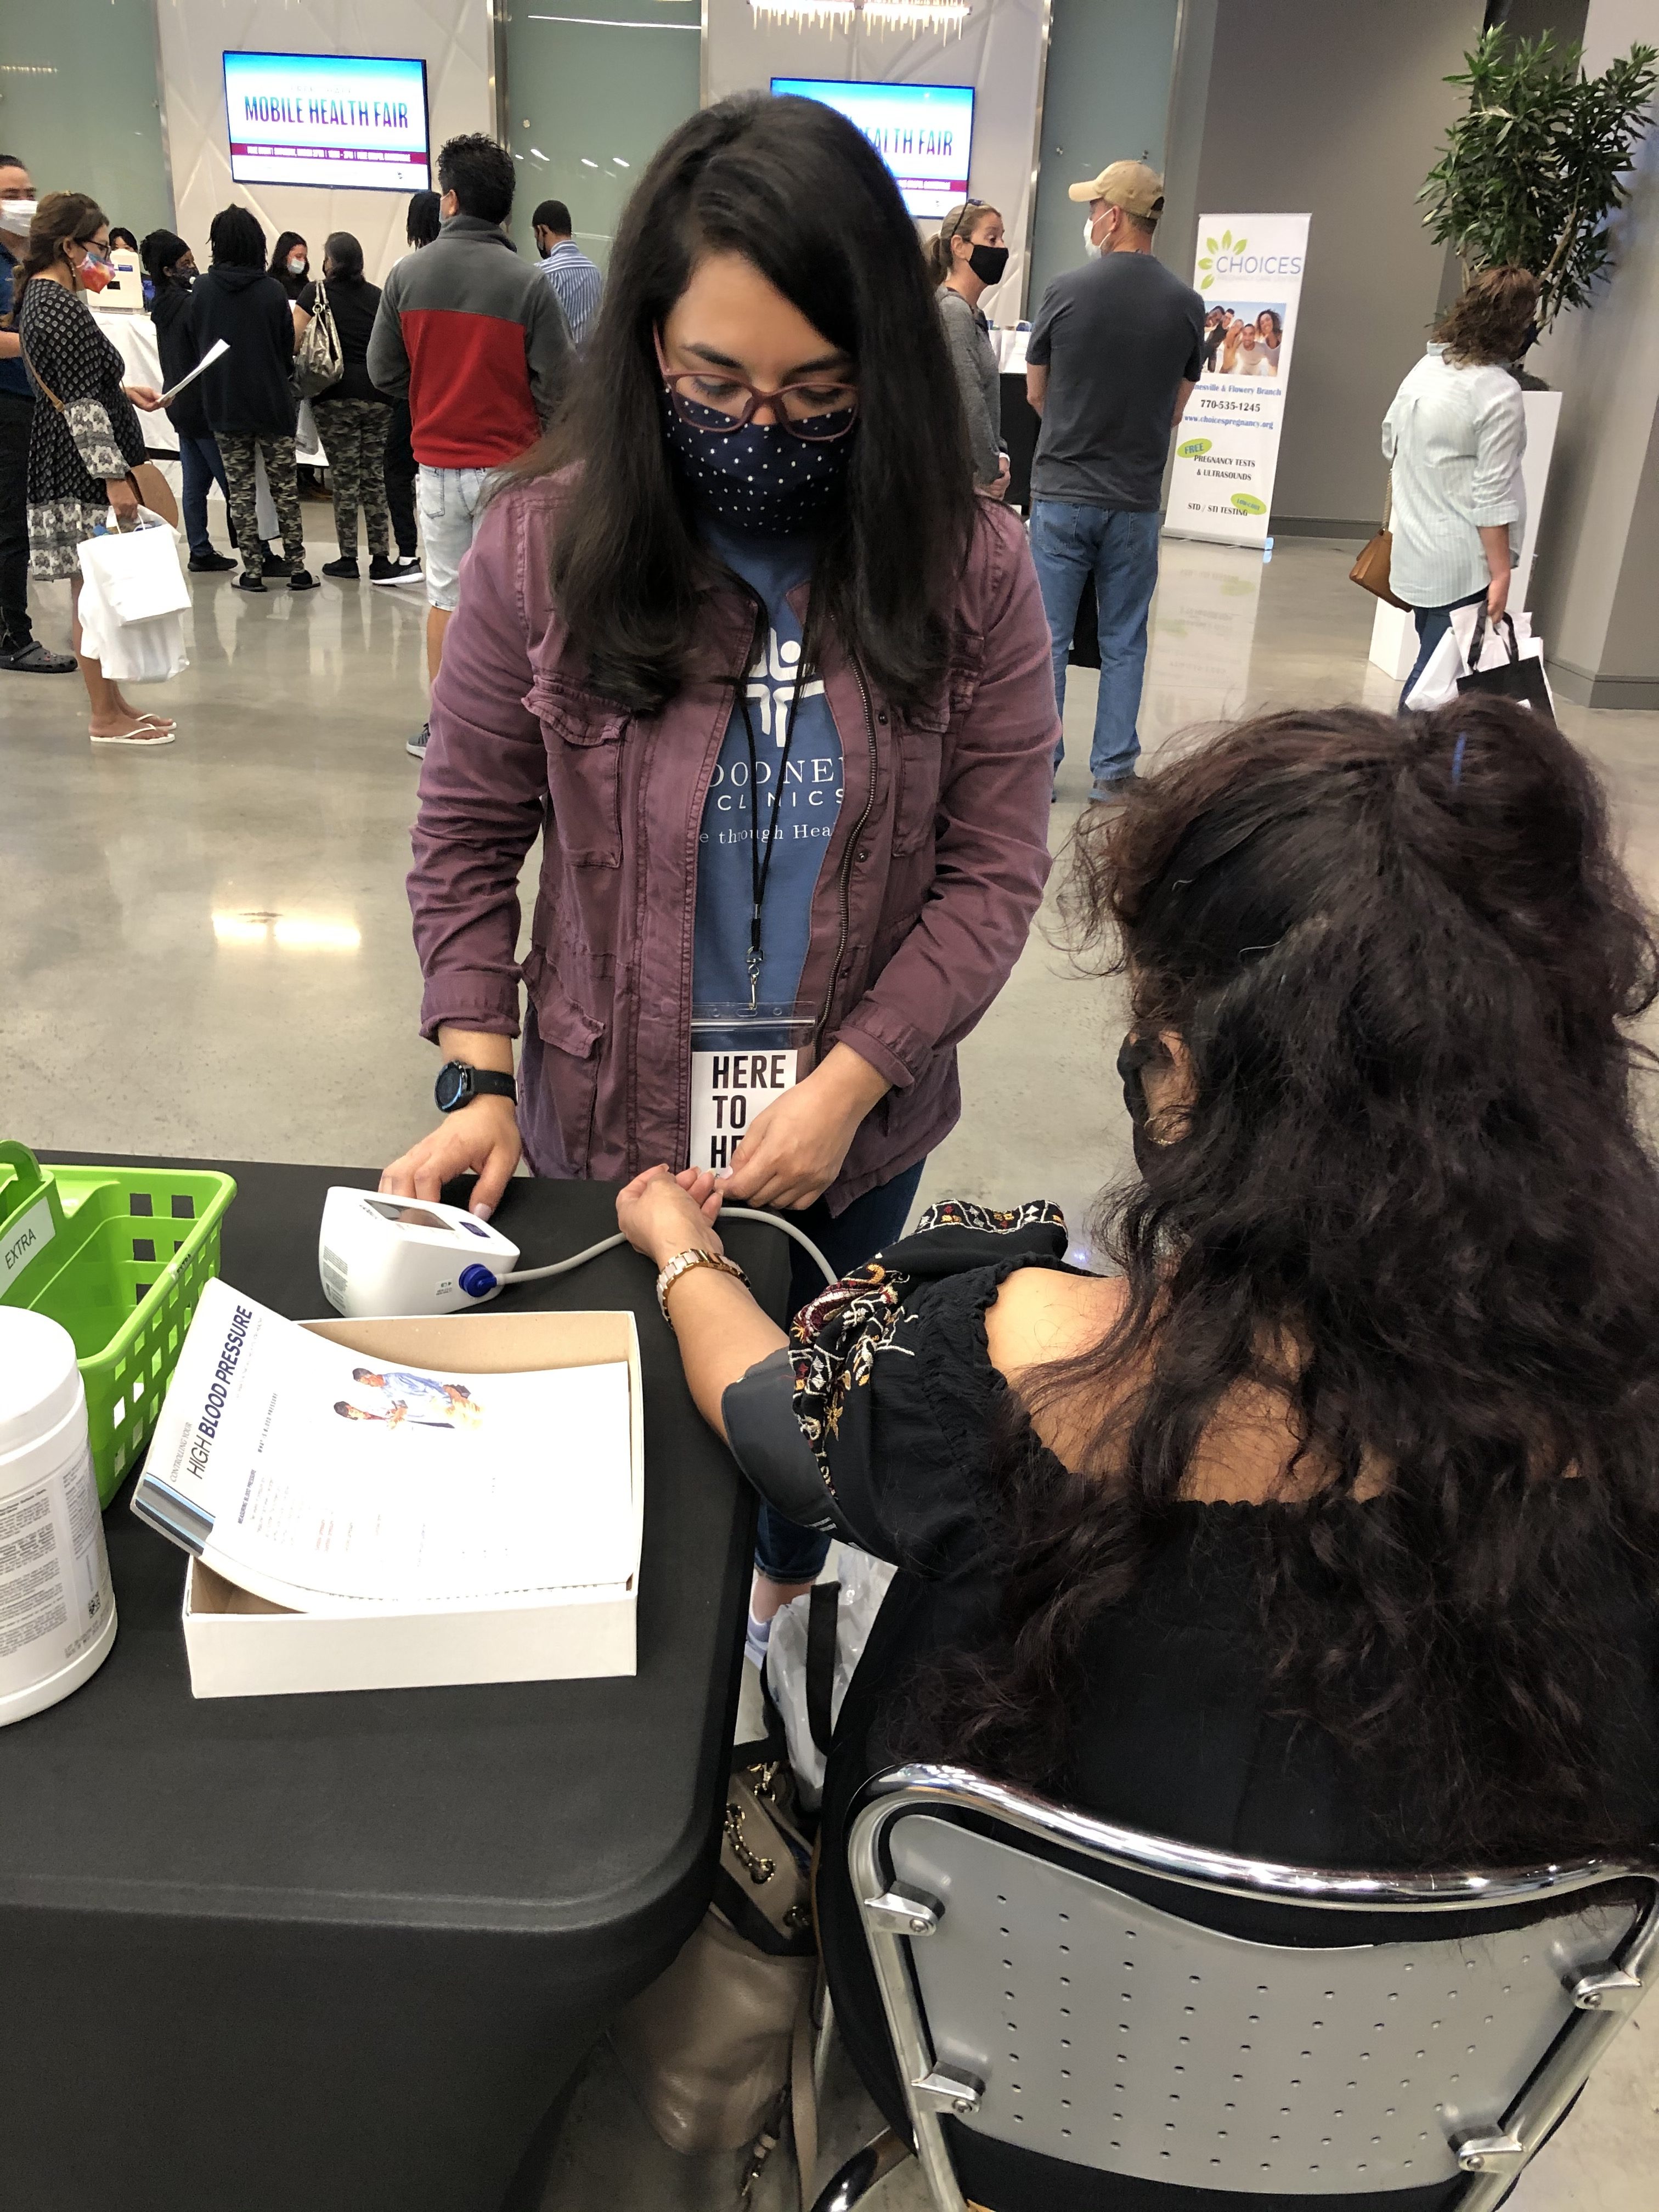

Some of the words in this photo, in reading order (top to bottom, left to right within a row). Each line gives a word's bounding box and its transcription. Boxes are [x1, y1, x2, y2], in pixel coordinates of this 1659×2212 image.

[244, 95, 304, 123] MOBILE
[308, 99, 369, 127] HEALTH
[374, 101, 408, 128] FAIR
[865, 127, 913, 154] ALTH
[918, 129, 953, 156] FAIR
[1216, 256, 1302, 274] CHOICES
[1228, 385, 1255, 394] Flowery
[1257, 387, 1282, 396] Branch
[1200, 399, 1261, 413] 770-535-1245
[1184, 415, 1274, 430] www.choicespregnancy.org
[1184, 443, 1204, 454] FREE
[1194, 454, 1234, 465] PREGNANCY
[1235, 459, 1256, 467] TESTS
[1203, 469, 1252, 481] ULTRASOUNDS
[1188, 502, 1201, 511] STD
[1207, 505, 1218, 513] STI
[1220, 506, 1248, 517] TESTING
[783, 756, 844, 784] NE
[717, 788, 844, 811] CLNICS
[792, 822, 836, 839] Hea
[712, 1054, 786, 1089] HERE
[712, 1094, 747, 1129] TO
[5, 1228, 37, 1269] EXTRA
[215, 1305, 253, 1385] PRESSURE
[198, 1383, 228, 1439] BLOOD
[170, 1437, 188, 1482] CONTROLLING
[182, 1421, 193, 1439] YOUR
[187, 1434, 212, 1480] HIGH
